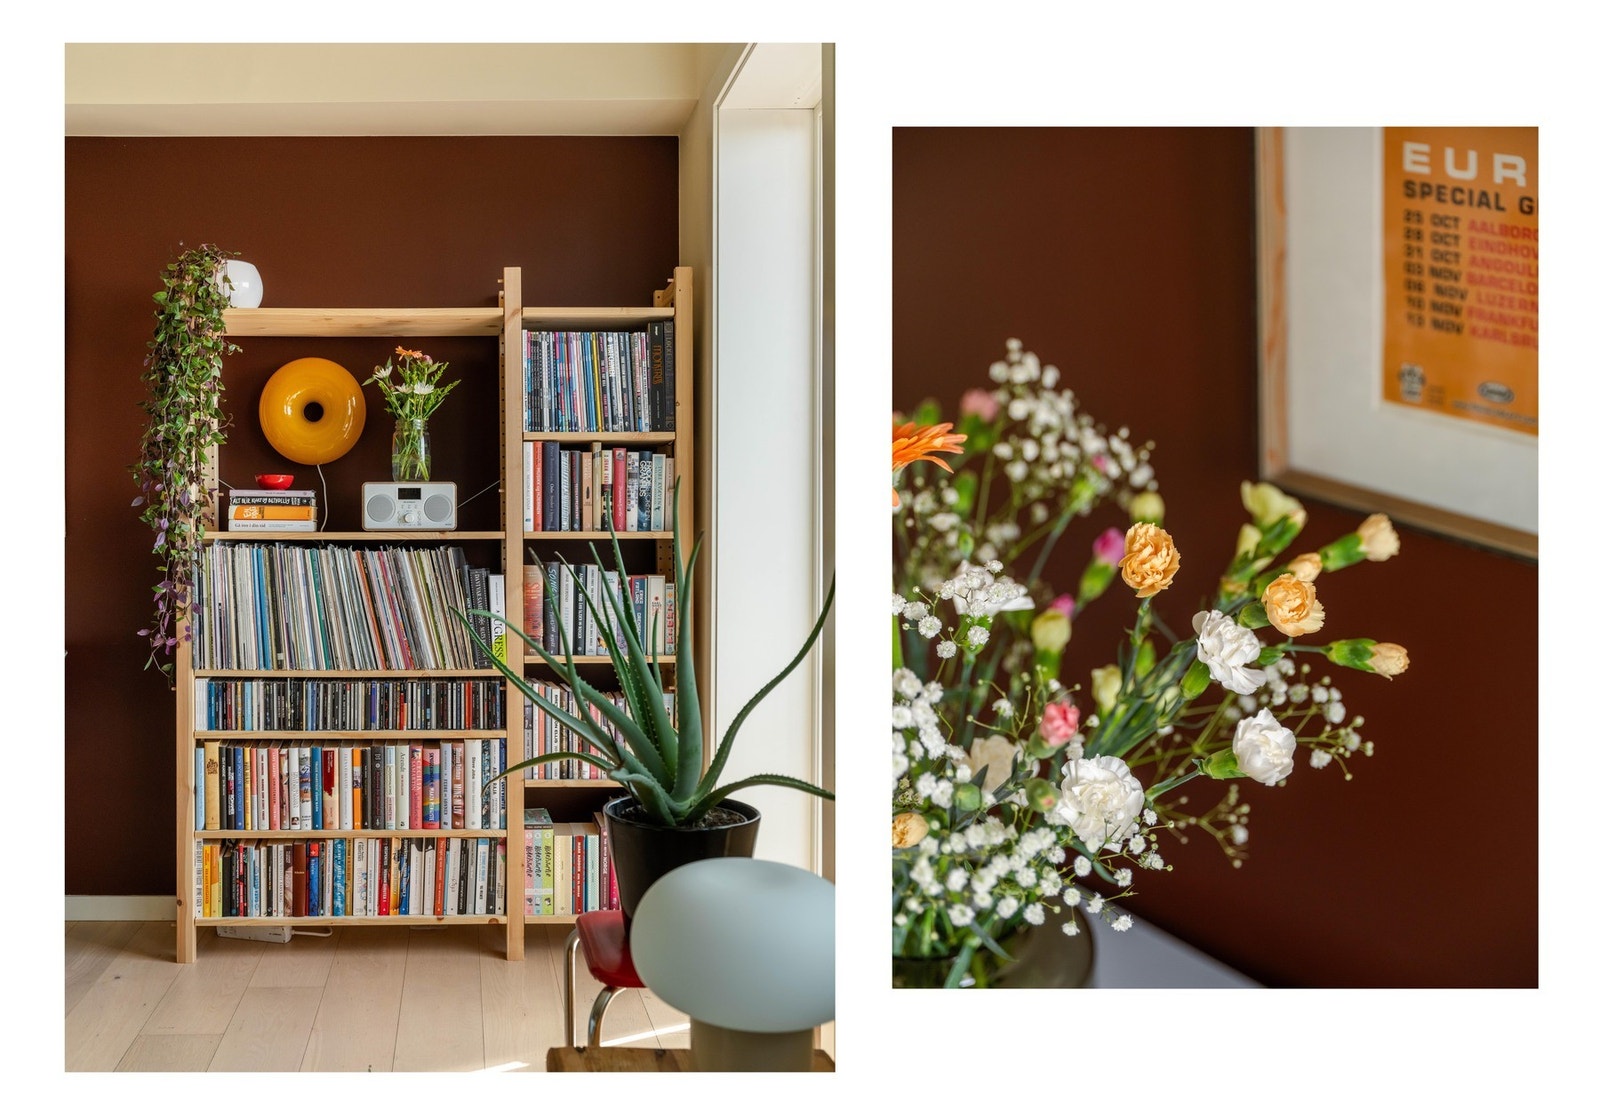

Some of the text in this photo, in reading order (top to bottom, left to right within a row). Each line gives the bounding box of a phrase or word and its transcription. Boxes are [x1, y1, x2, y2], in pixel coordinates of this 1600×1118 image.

[1403, 141, 1527, 187] EUR
[1404, 179, 1538, 216] SPECIAL G
[1430, 213, 1461, 230] OCT
[1430, 230, 1461, 247] OCT
[1430, 248, 1461, 265] OCT
[1429, 265, 1462, 283] NOV
[1433, 282, 1468, 302] NOV
[1429, 300, 1464, 318] NOV
[1430, 317, 1465, 336] NOV
[607, 344, 615, 377] WATCHMEN
